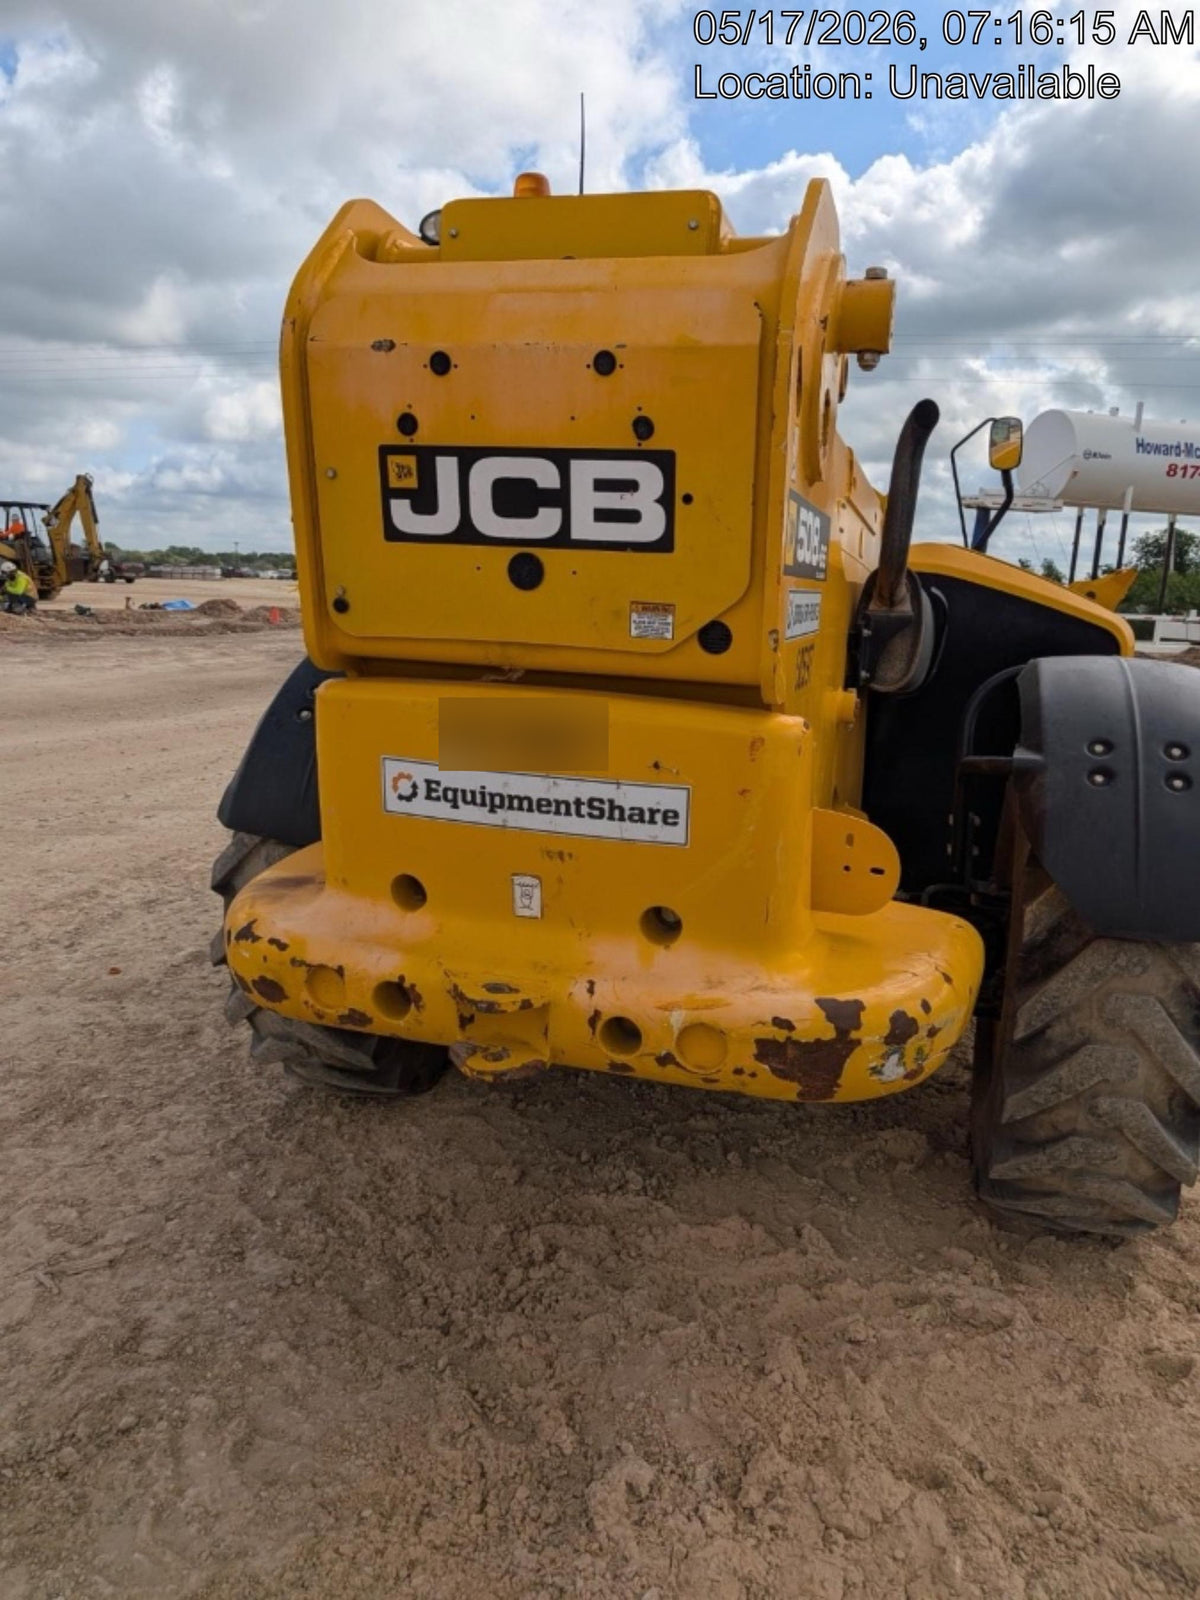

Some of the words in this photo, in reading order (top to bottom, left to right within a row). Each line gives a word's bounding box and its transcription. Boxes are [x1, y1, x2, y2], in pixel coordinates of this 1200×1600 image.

[389, 456, 666, 543] JCB
[796, 506, 820, 566] 508
[423, 778, 680, 827] EquipmentShare
